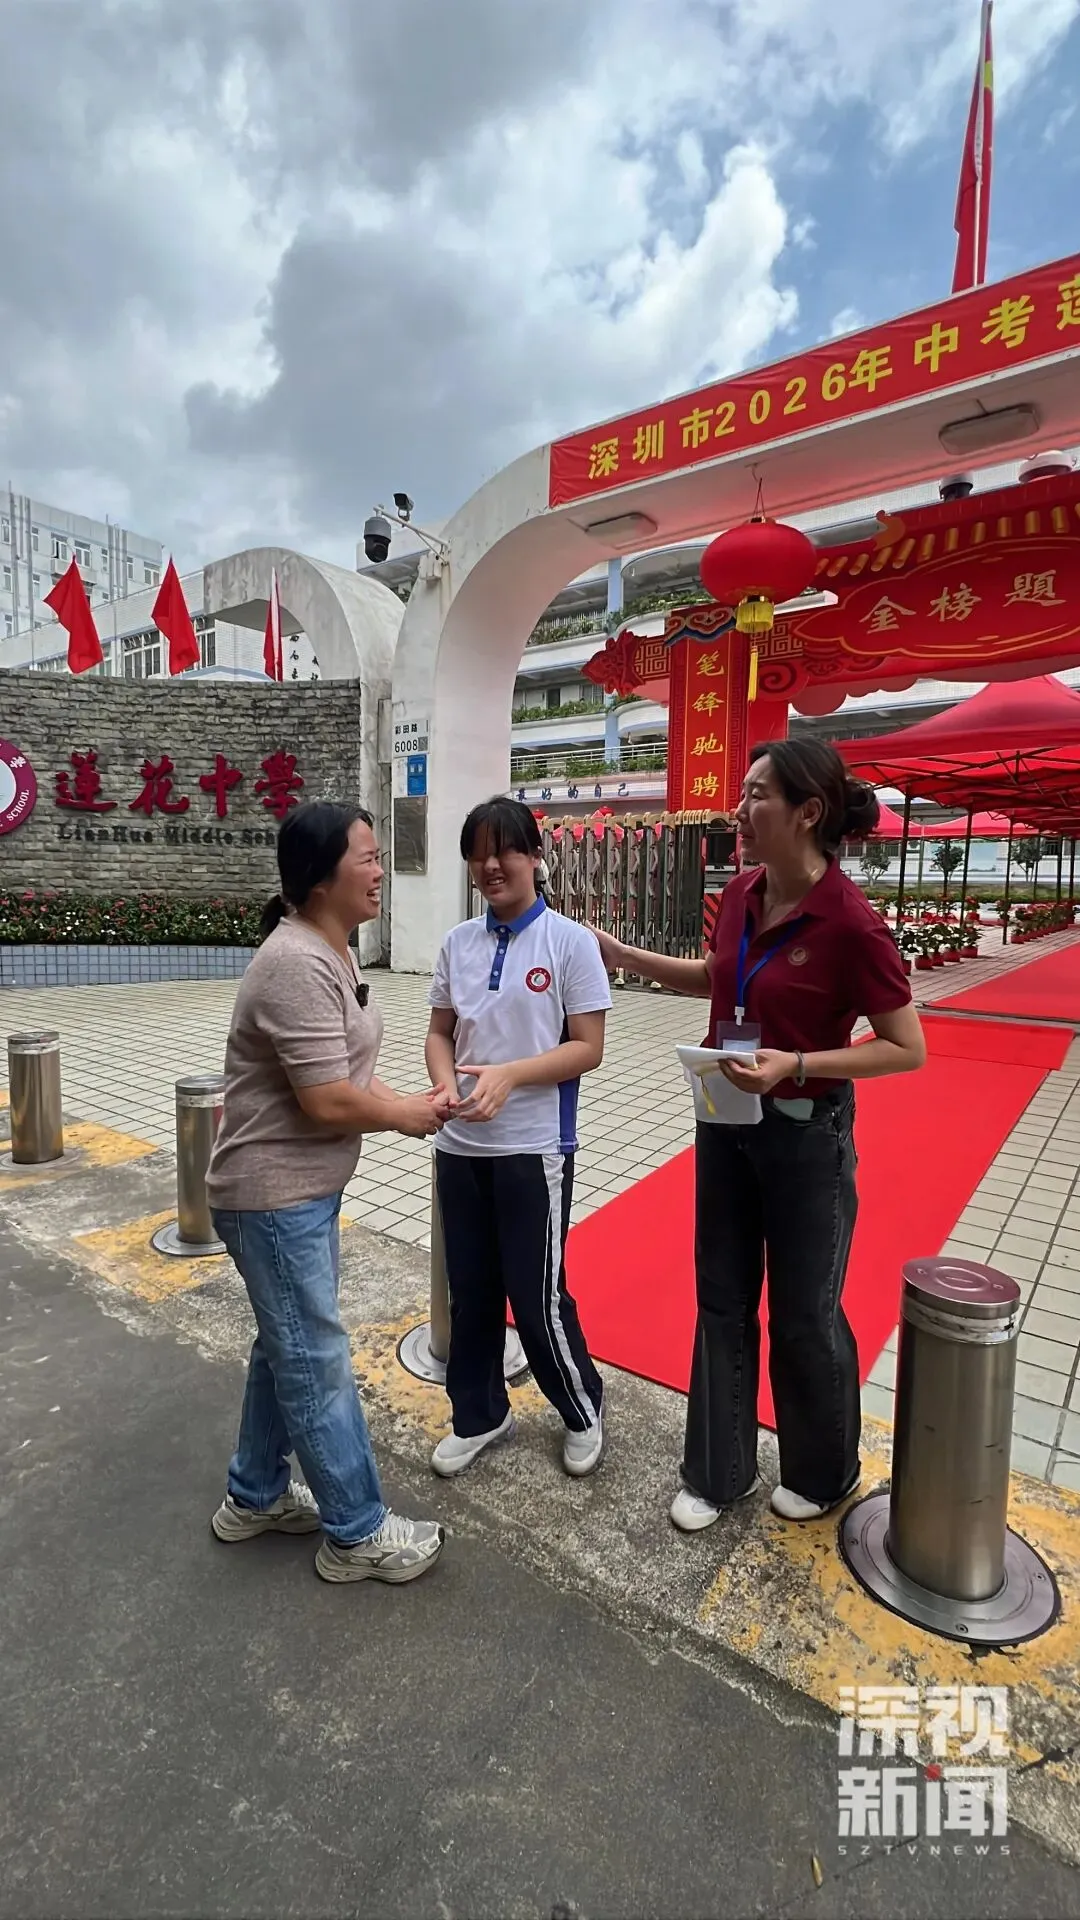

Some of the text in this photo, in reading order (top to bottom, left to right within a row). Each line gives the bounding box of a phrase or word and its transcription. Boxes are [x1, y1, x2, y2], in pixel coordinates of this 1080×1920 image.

[690, 650, 725, 798] 笔锋驰骋
[394, 739, 418, 753] 6008
[515, 782, 629, 801] 最好的自己
[6, 789, 30, 821] SCHOOL
[165, 825, 234, 844] Middle
[243, 827, 275, 846] Sch
